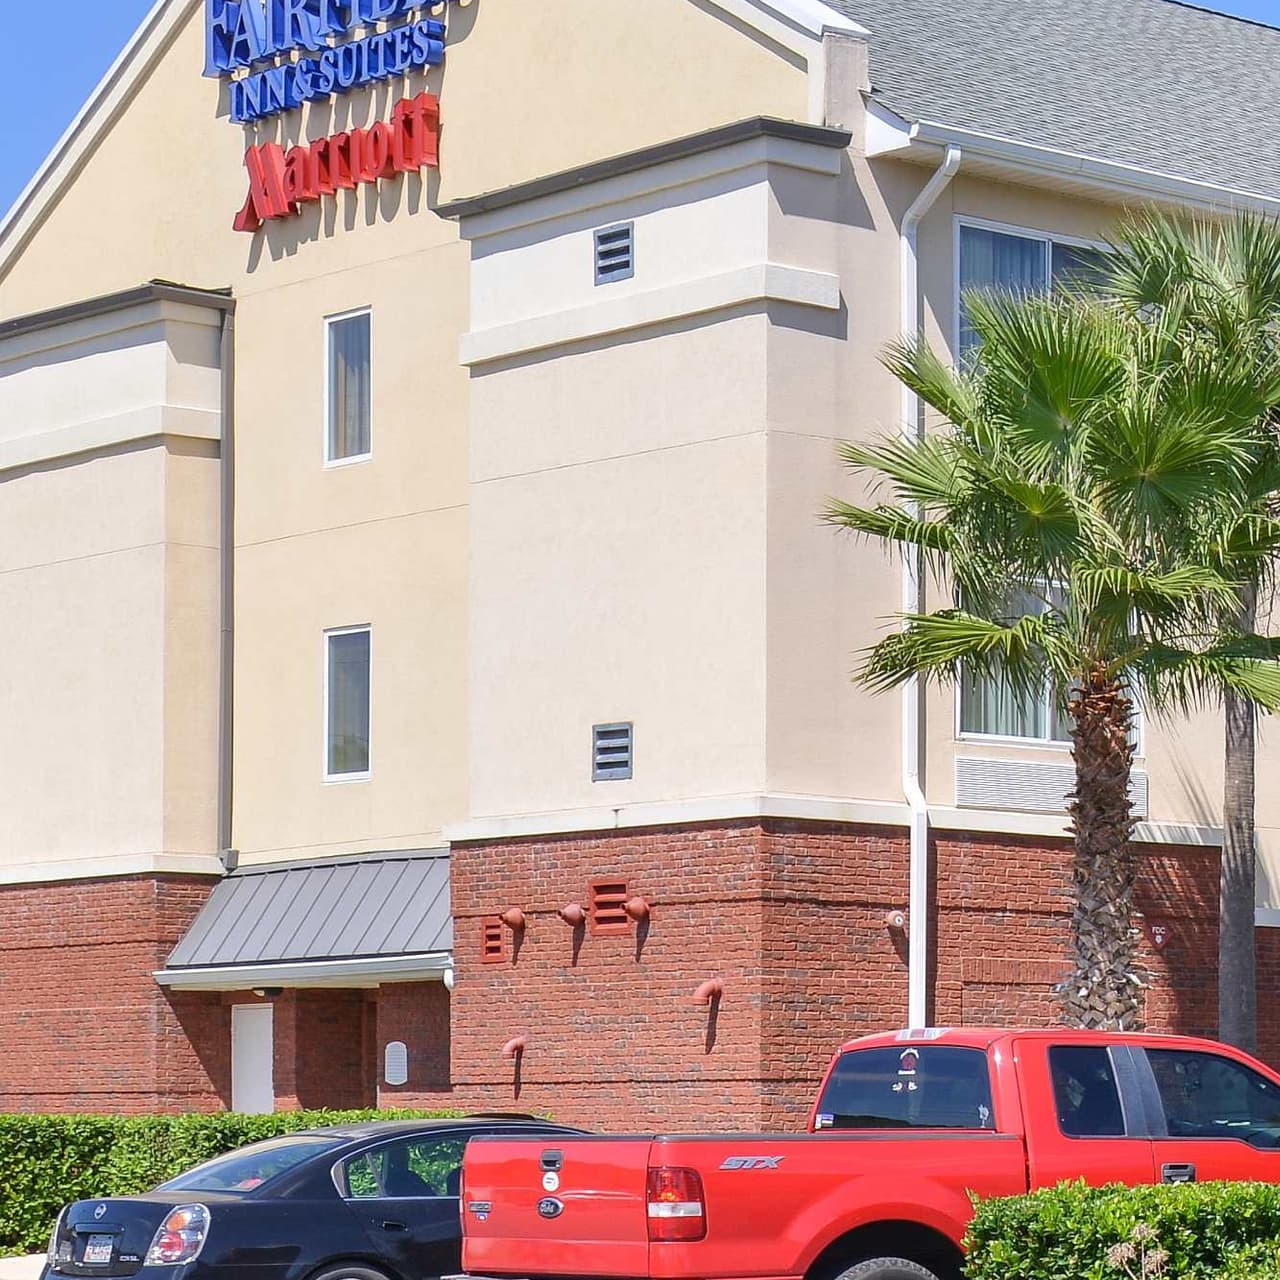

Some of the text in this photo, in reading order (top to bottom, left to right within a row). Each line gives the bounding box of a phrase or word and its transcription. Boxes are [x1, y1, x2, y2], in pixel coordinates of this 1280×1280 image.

[228, 64, 303, 124] INN
[319, 19, 446, 96] SUITES
[233, 91, 440, 233] Marriott
[719, 1155, 785, 1170] STX
